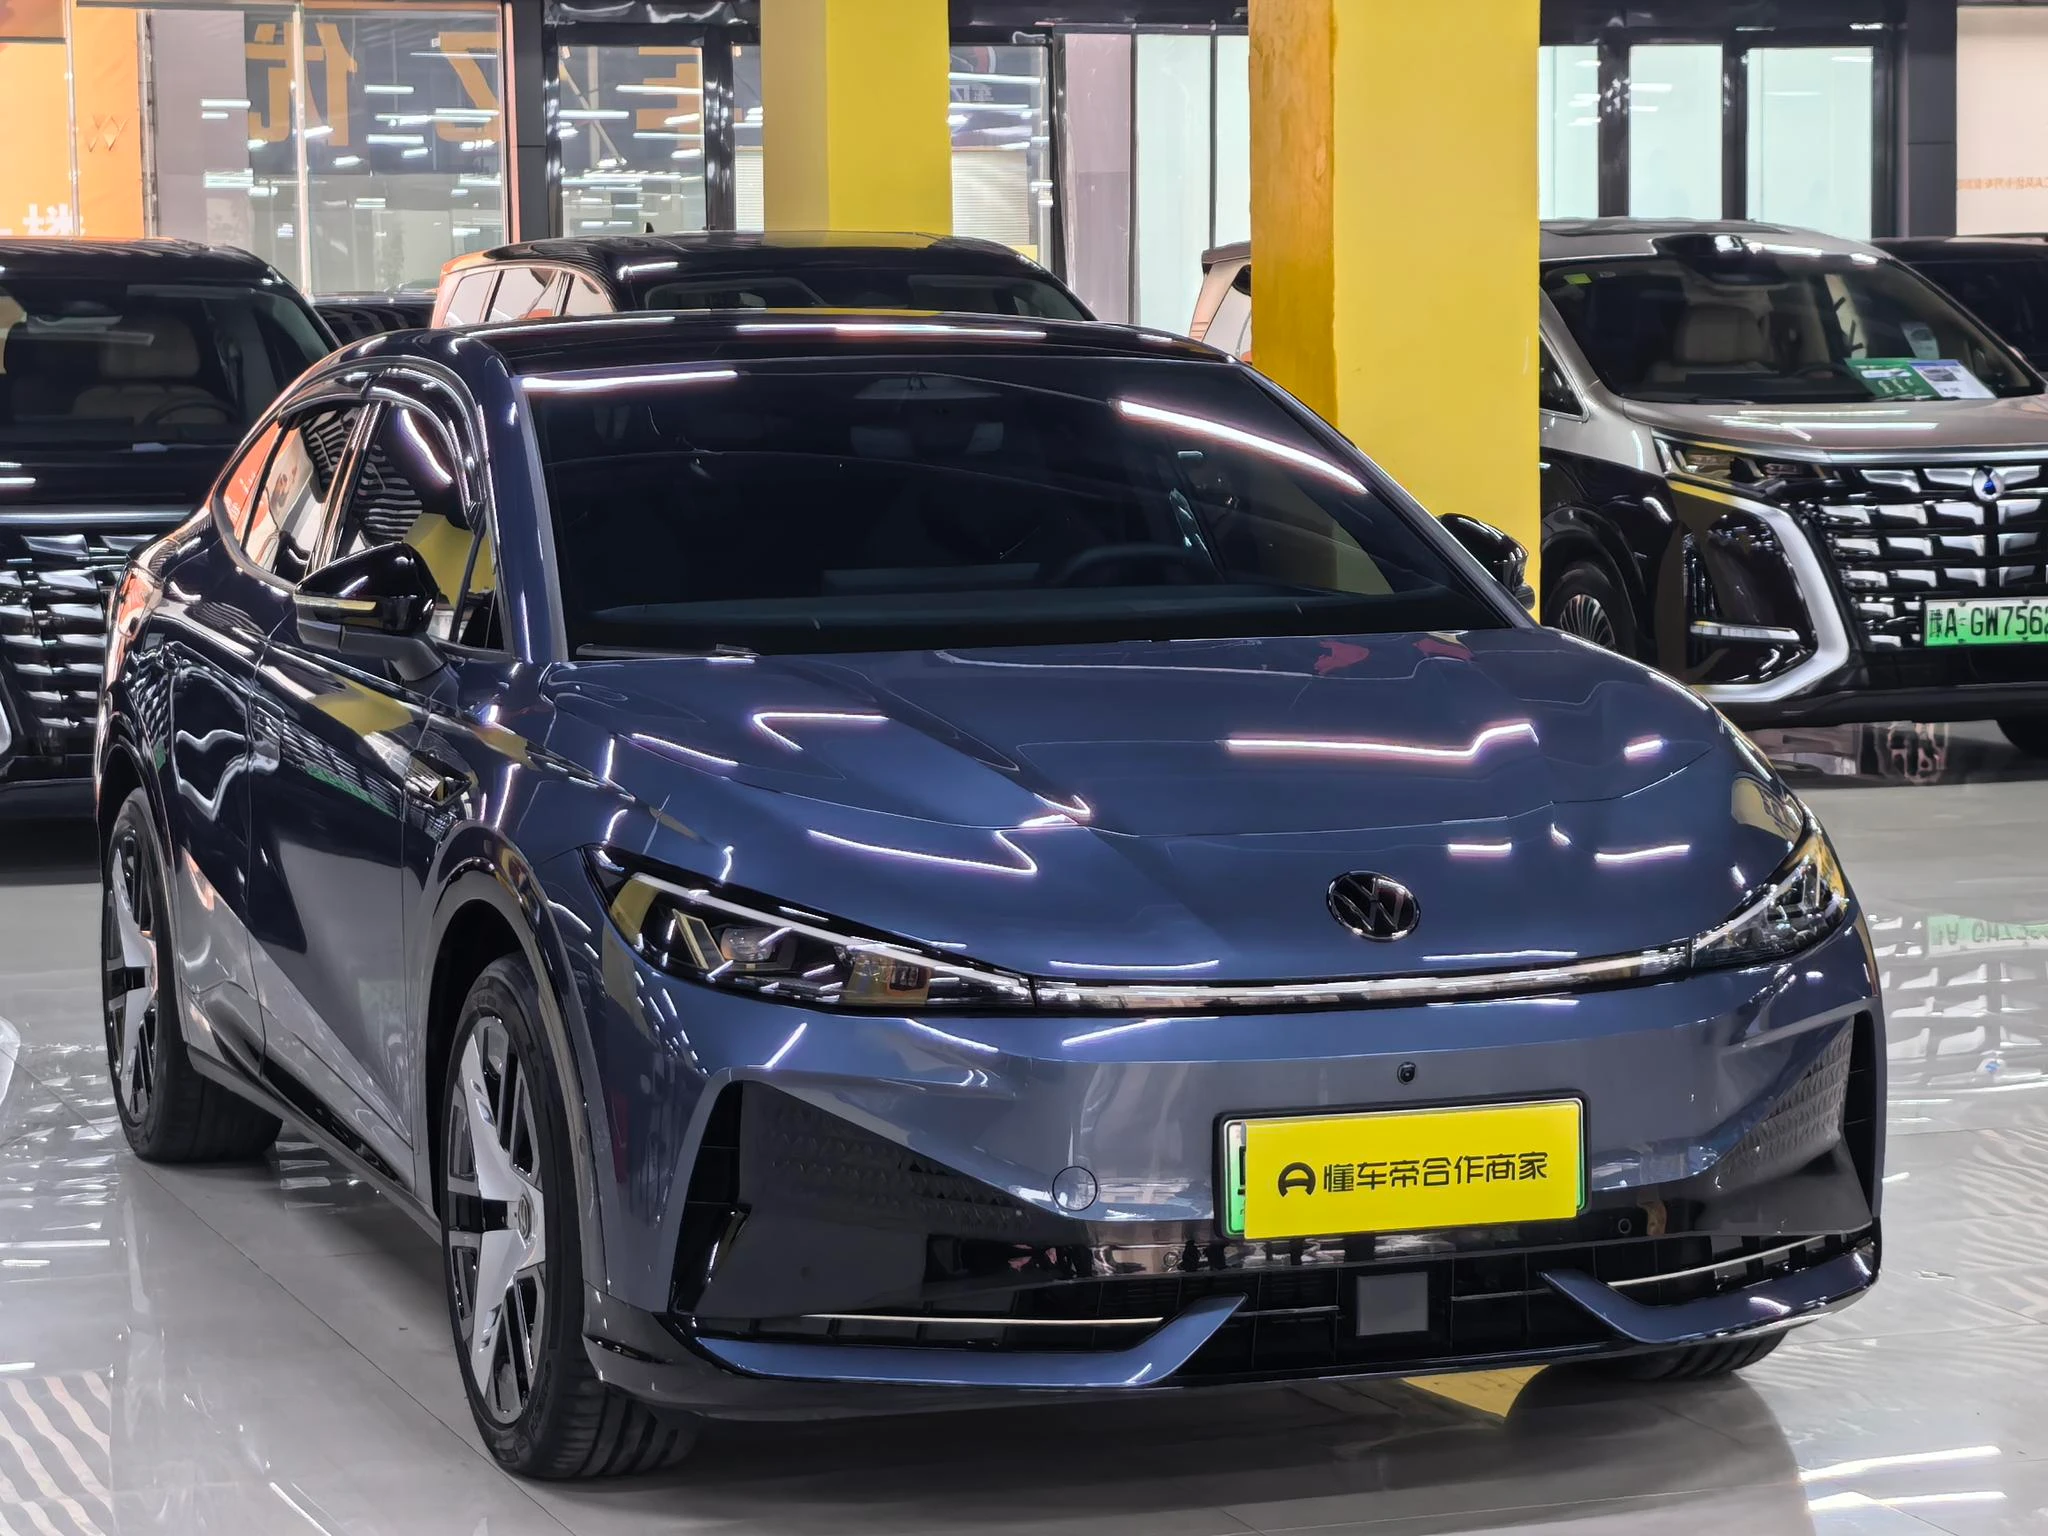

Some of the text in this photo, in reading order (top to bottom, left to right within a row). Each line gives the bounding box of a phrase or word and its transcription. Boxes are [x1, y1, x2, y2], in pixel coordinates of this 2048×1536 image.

[1323, 1151, 1548, 1193] 懂车帝合作商家
